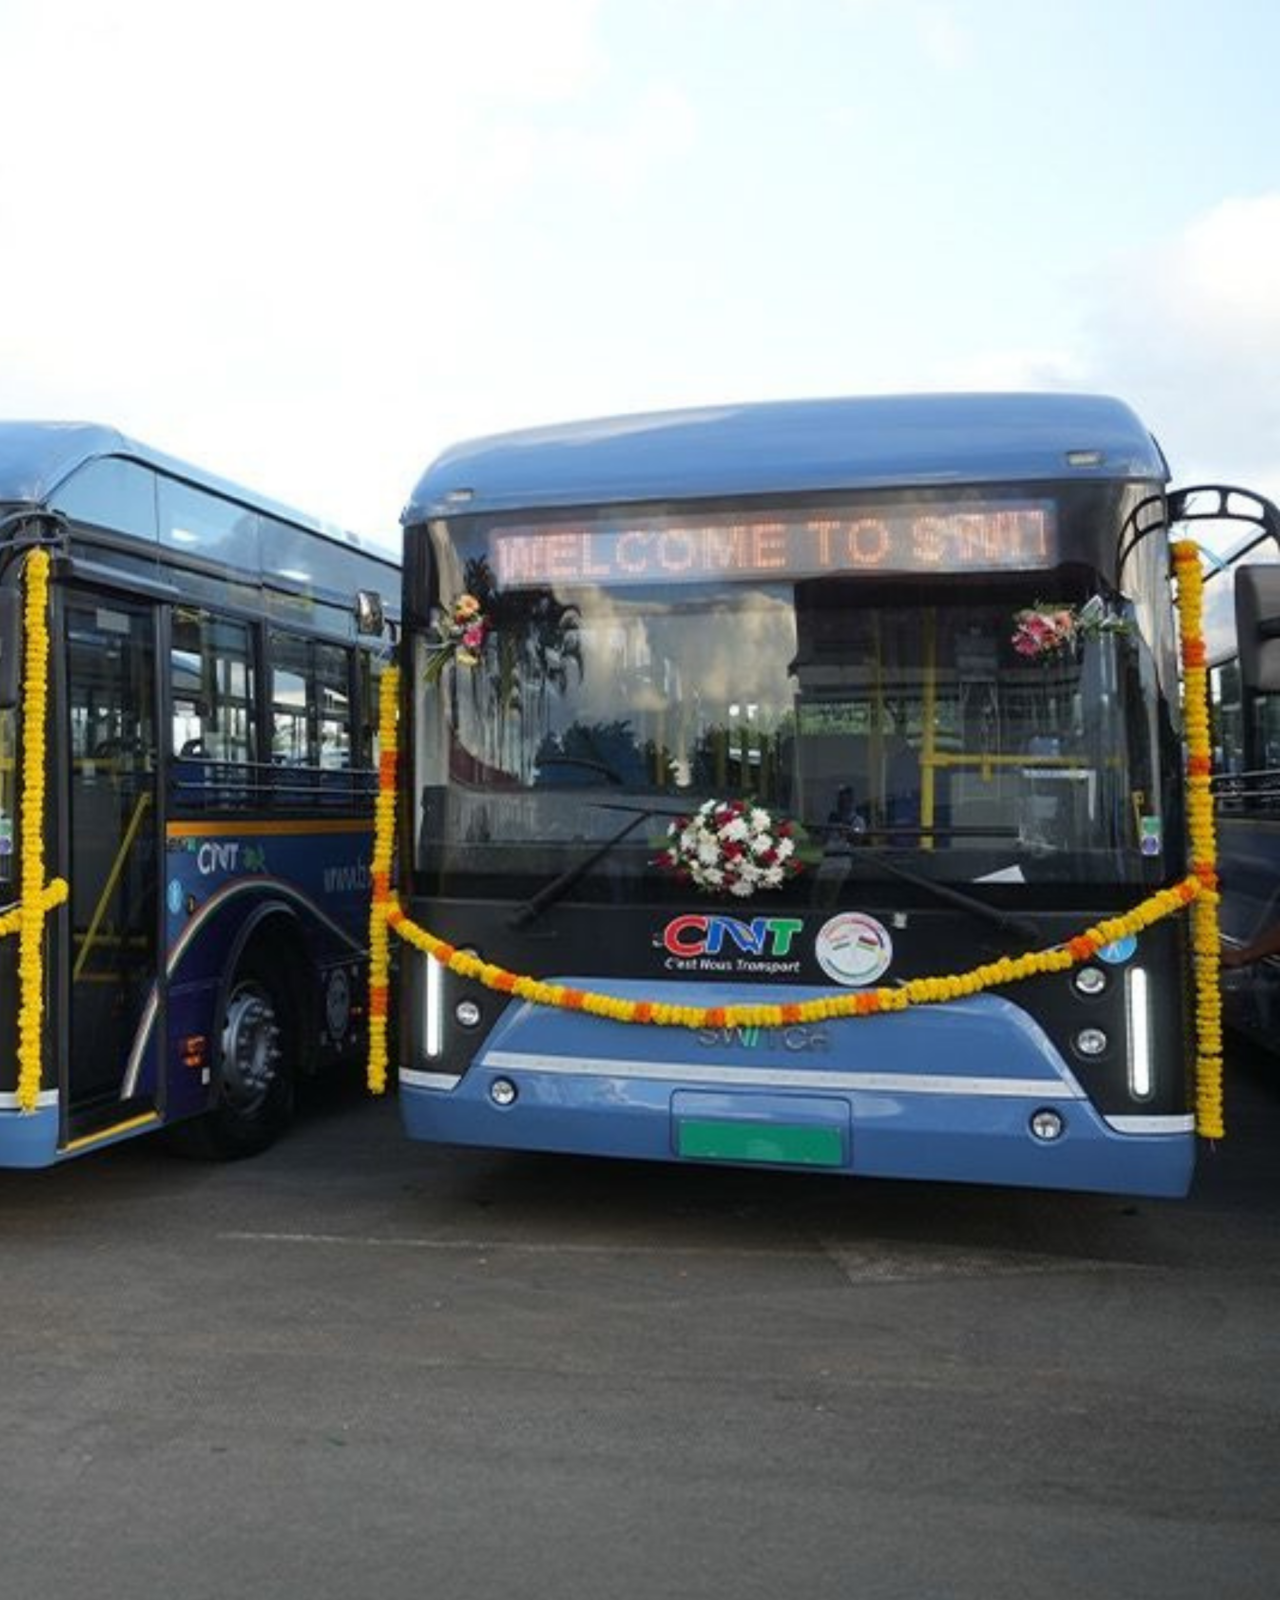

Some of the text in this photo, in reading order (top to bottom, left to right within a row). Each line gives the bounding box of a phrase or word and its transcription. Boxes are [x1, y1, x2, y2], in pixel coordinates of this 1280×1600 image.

[496, 522, 788, 581] WELCOME
[807, 517, 890, 566] TO
[197, 842, 239, 874] CNT
[663, 914, 804, 958] CNT
[664, 956, 801, 974] C'est Nous Transport
